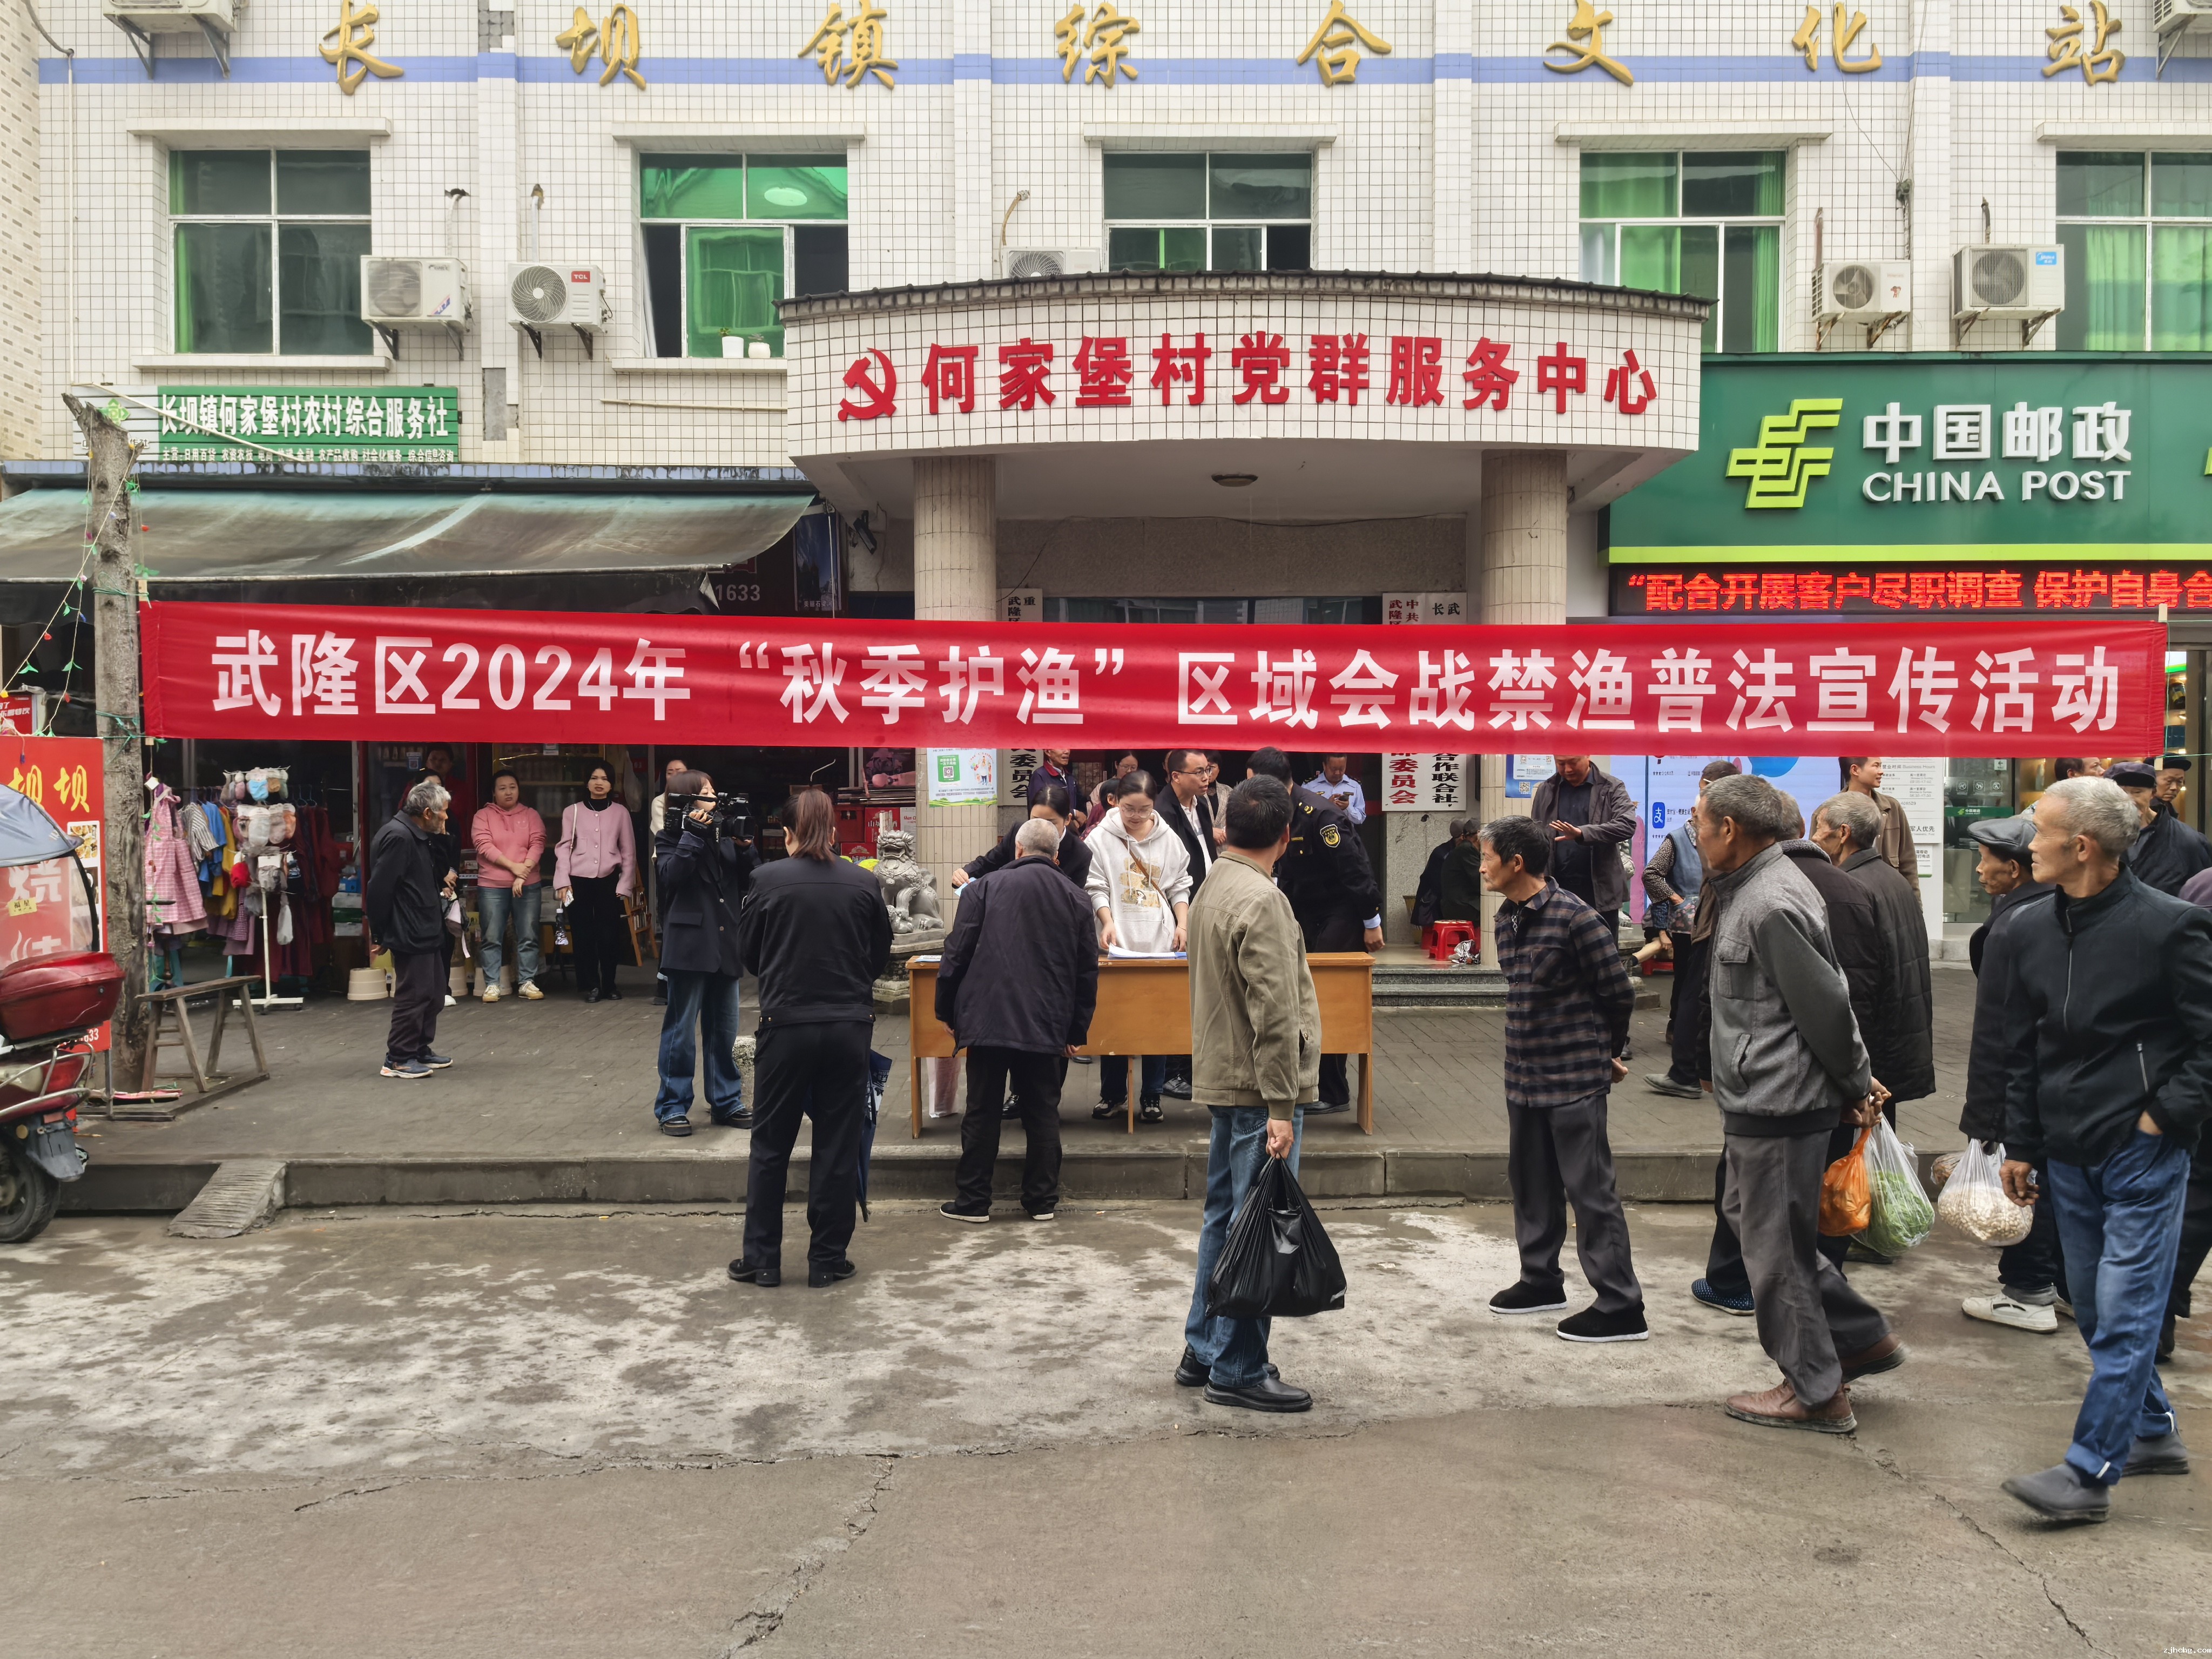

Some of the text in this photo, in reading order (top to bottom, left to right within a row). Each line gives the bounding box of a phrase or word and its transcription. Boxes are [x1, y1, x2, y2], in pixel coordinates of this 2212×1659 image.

[318, 0, 2125, 95] 长坝镇综合文化站
[921, 330, 1657, 415] 何家堡村党群服务中心
[161, 394, 449, 440] 长坝镇何家堡村农村综合服务社
[1863, 401, 2132, 463] 中国邮政
[1863, 470, 2132, 502] CHINA POST
[715, 584, 760, 602] 1633
[1010, 748, 1037, 798] 委员会
[1388, 753, 1419, 804] 委员会
